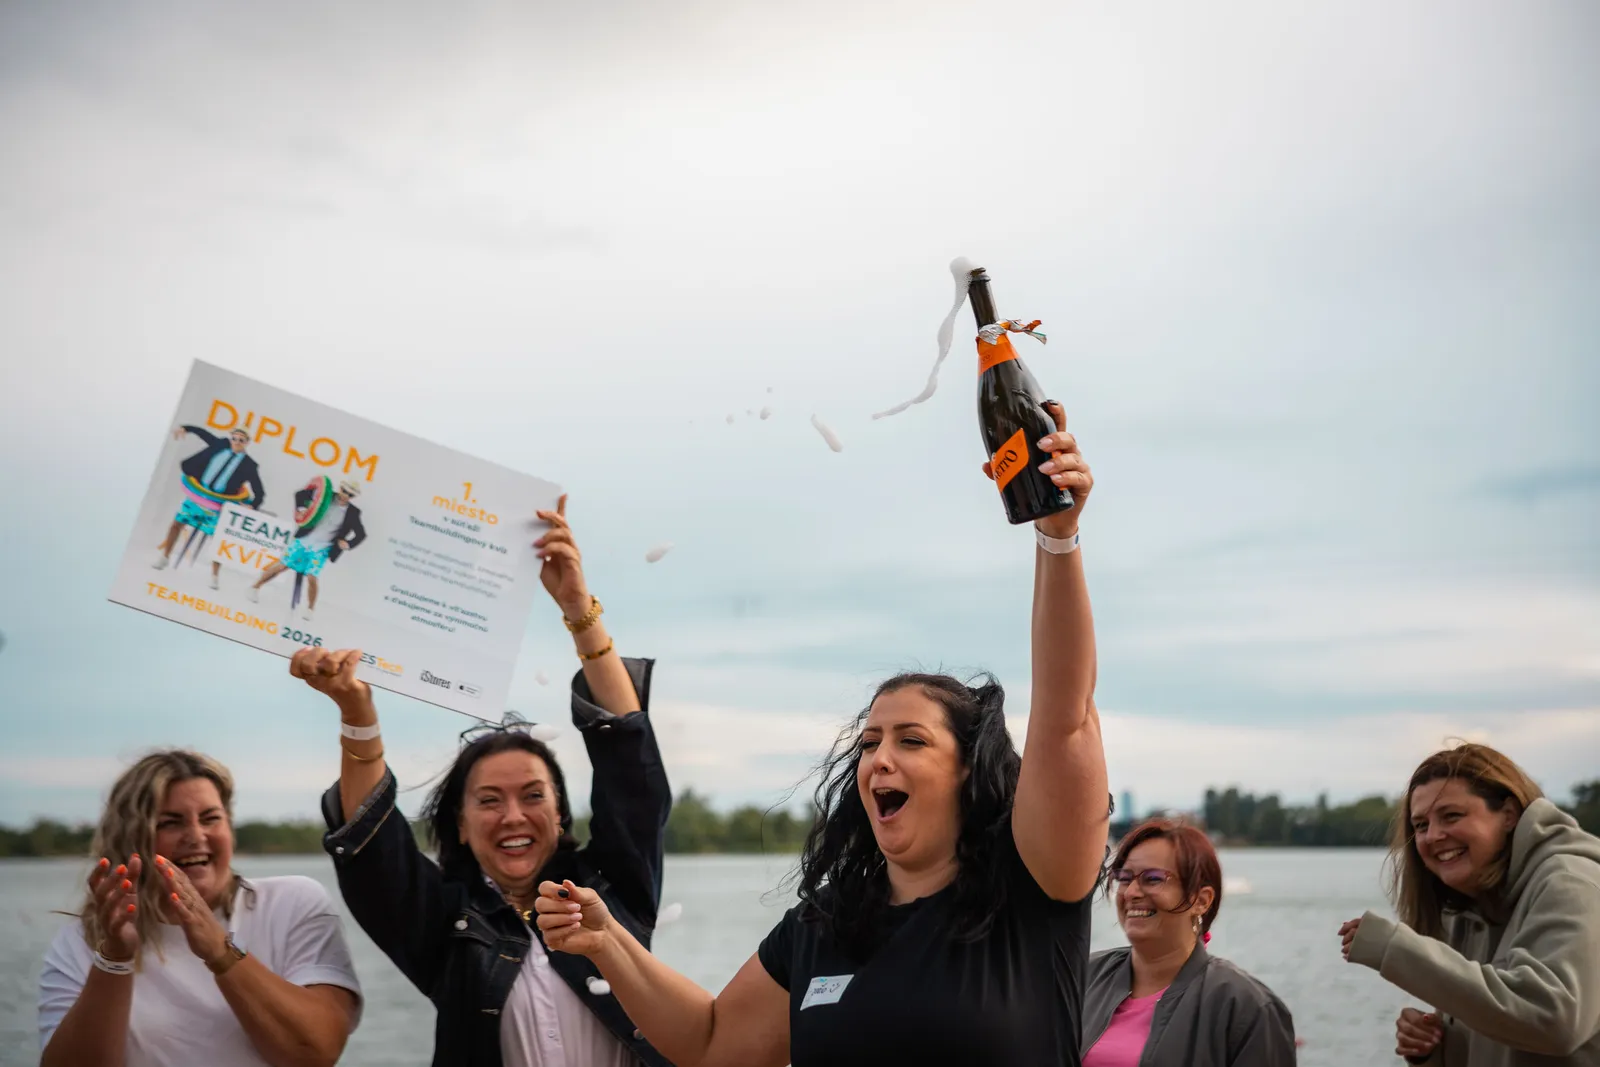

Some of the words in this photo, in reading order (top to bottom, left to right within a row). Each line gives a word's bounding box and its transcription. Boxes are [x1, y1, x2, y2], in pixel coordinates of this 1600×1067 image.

[206, 398, 380, 482] DIPLOM
[462, 481, 477, 504] 1.
[432, 495, 499, 525] miesto
[229, 510, 291, 545] TEAM
[217, 540, 281, 571] KVÍZ
[147, 582, 279, 635] TEAMBUILDING
[281, 626, 323, 648] 2026
